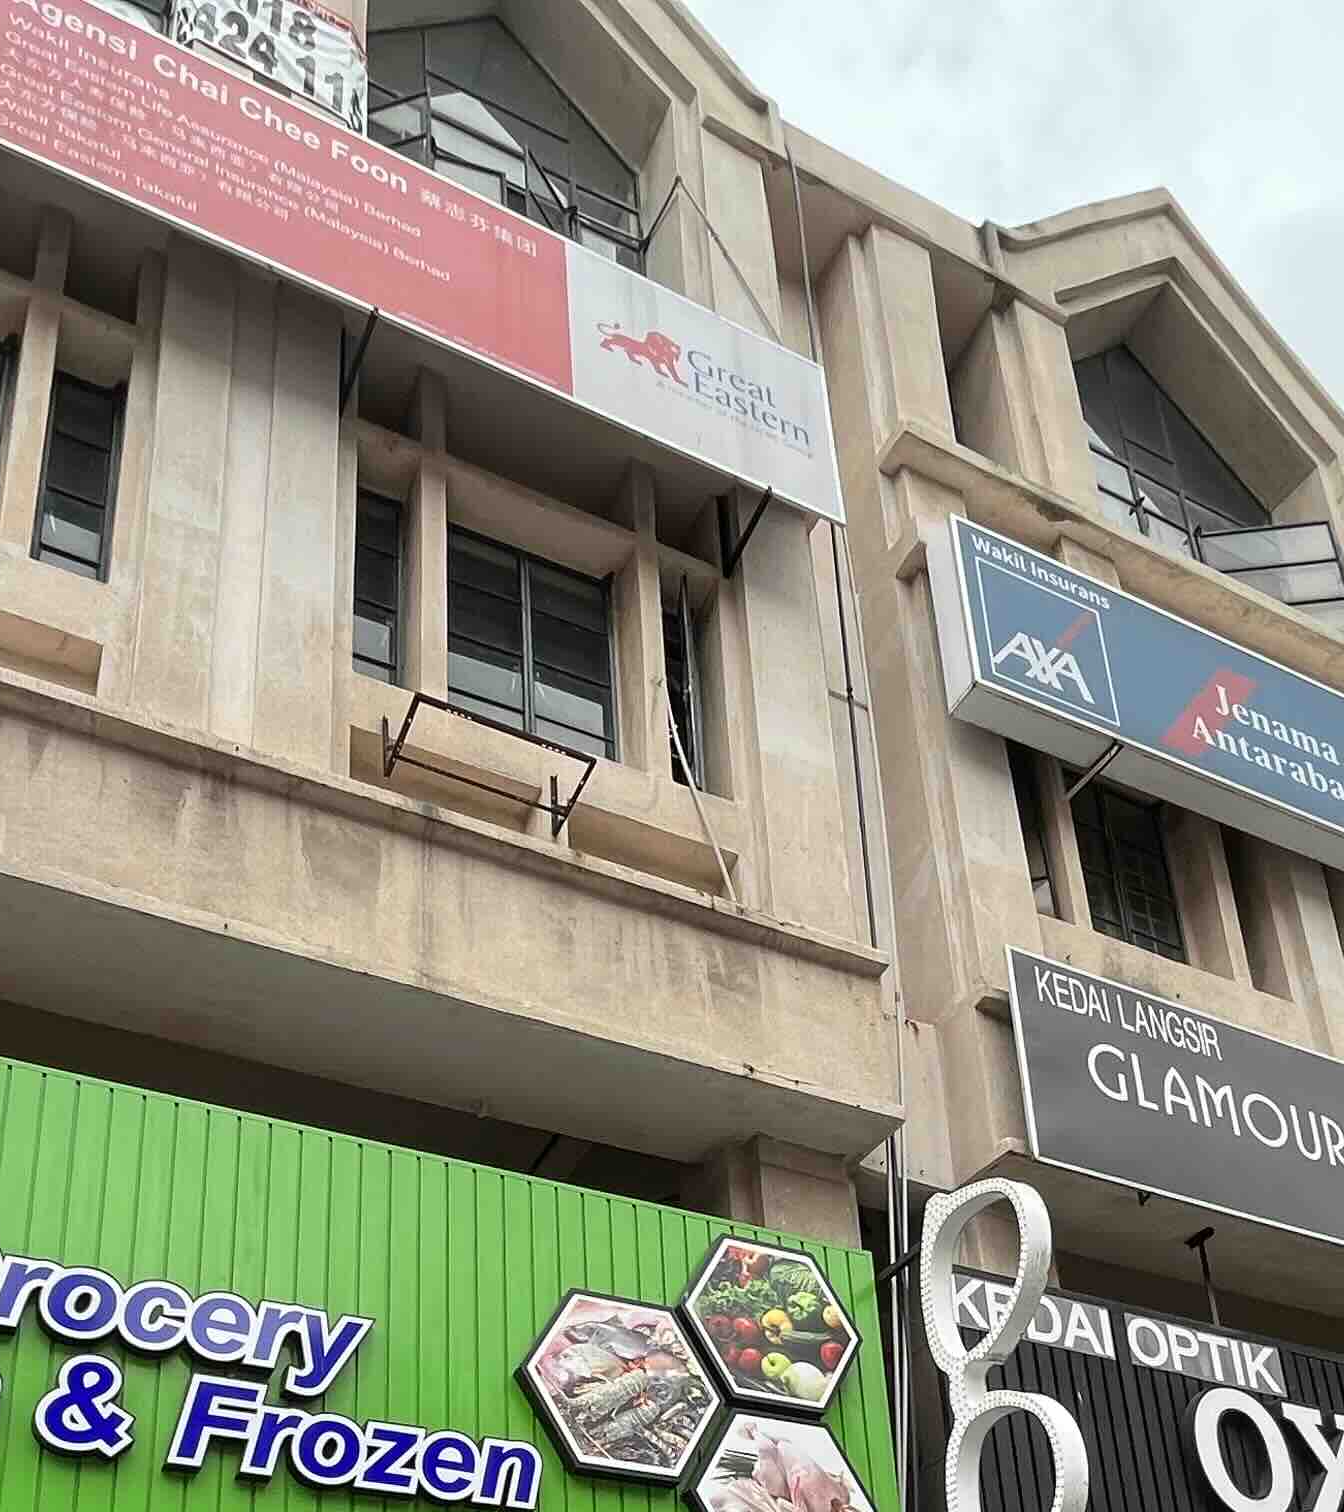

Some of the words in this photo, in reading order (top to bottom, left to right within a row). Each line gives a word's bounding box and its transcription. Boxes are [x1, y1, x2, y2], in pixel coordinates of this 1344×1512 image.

[9, 11, 69, 52] Wakil
[77, 46, 171, 100] Insurans
[5, 30, 58, 62] Great
[64, 56, 136, 100] Eastern
[141, 95, 175, 119] Life
[177, 113, 270, 163] Assurance
[364, 200, 423, 238] Berhad
[56, 119, 122, 161] Takaful
[152, 54, 229, 105] Chai
[239, 96, 321, 150] Chee
[331, 140, 408, 192] Foon
[0, 62, 55, 97] Great
[60, 89, 133, 133] Eastern
[137, 126, 209, 169] General
[214, 164, 299, 212] Insurance
[304, 207, 389, 257] (Malaysia)
[391, 246, 452, 282] Berhad
[53, 138, 127, 182] Eastern
[134, 174, 199, 213] Takaful
[687, 350, 777, 408] Great
[694, 371, 811, 446] Eastern
[971, 534, 1027, 572] Wakil
[1030, 561, 1110, 609] Insurans
[993, 632, 1096, 705] AXA
[1215, 683, 1340, 767] Jenama
[1033, 964, 1111, 1024] KEDAI
[1117, 993, 1223, 1062] LANGSIR
[1125, 1315, 1284, 1395] OPTIK
[34, 1353, 137, 1457] &
